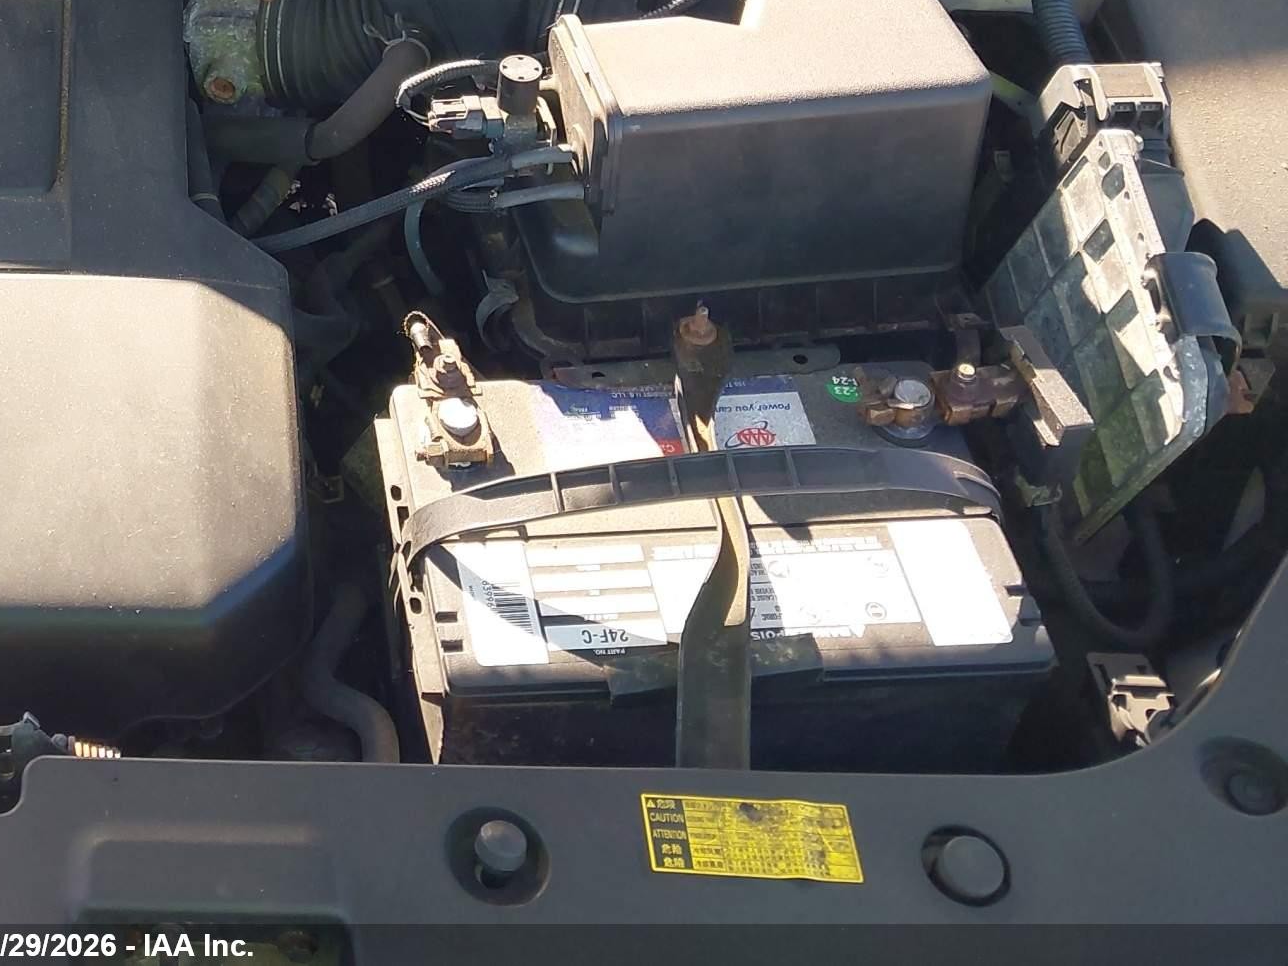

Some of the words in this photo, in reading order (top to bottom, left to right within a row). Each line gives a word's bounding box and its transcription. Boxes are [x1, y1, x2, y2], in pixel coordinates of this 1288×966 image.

[735, 401, 757, 412] you
[757, 402, 791, 412] Power
[581, 628, 629, 644] 24F-C
[649, 812, 685, 824] CAUTION
[652, 829, 687, 840] ATTENTION
